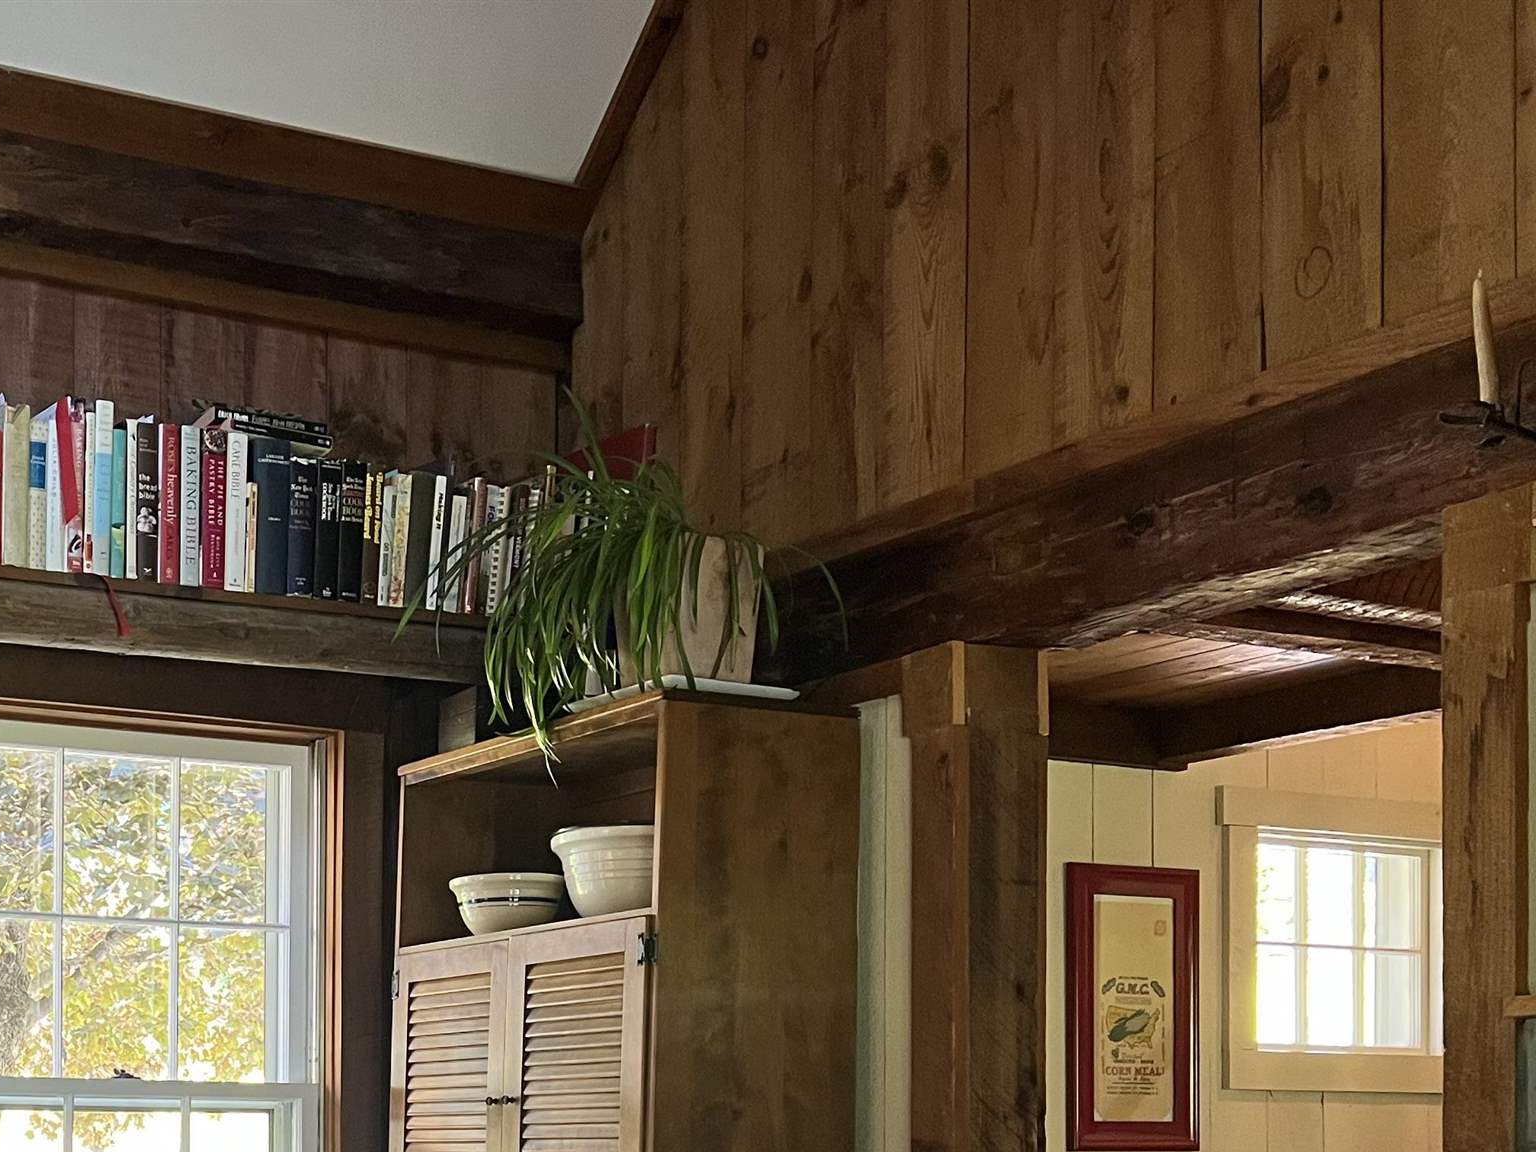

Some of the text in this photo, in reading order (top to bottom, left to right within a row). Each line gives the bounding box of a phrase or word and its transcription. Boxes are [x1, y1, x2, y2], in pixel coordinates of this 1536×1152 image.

[75, 428, 83, 468] BAKING
[167, 437, 176, 473] ROSE'S
[138, 473, 150, 482] the
[138, 482, 157, 492] bread
[230, 441, 240, 500] CAKE BIBLE
[138, 491, 156, 500] bible
[163, 474, 178, 525] heavenly
[185, 446, 197, 567] BAKING BIBLE
[207, 499, 216, 525] BIBLE
[363, 473, 375, 539] James Beard
[373, 472, 384, 544] Beard on Food
[436, 493, 444, 523] Making
[513, 536, 523, 568] VERMONT
[1105, 1065, 1162, 1077] CORN MEAL
